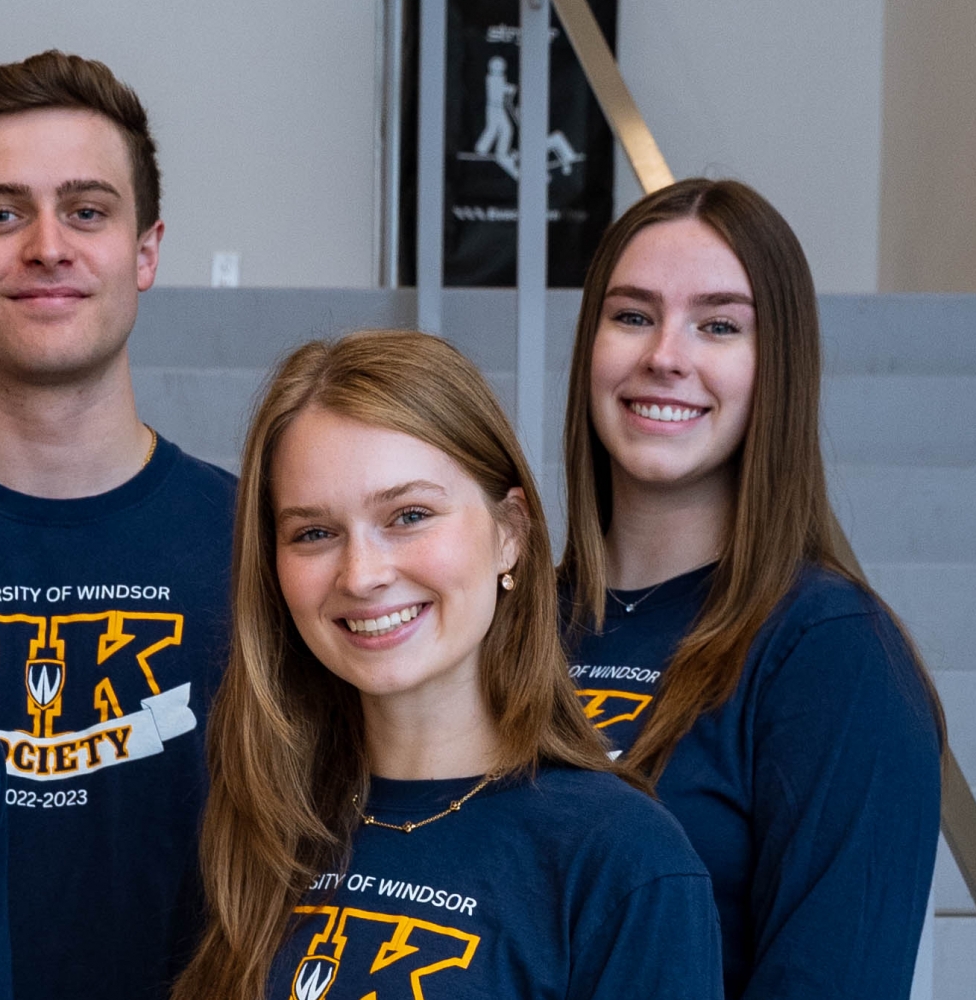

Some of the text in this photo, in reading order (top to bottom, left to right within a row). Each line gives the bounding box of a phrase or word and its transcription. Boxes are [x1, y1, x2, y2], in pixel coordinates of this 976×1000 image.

[46, 585, 73, 602] OF
[77, 584, 171, 601] WINDSOR
[588, 665, 661, 684] WINDSOR
[5, 788, 89, 809] 022-2023
[347, 873, 376, 893] OF
[378, 878, 477, 916] WINDSOR
